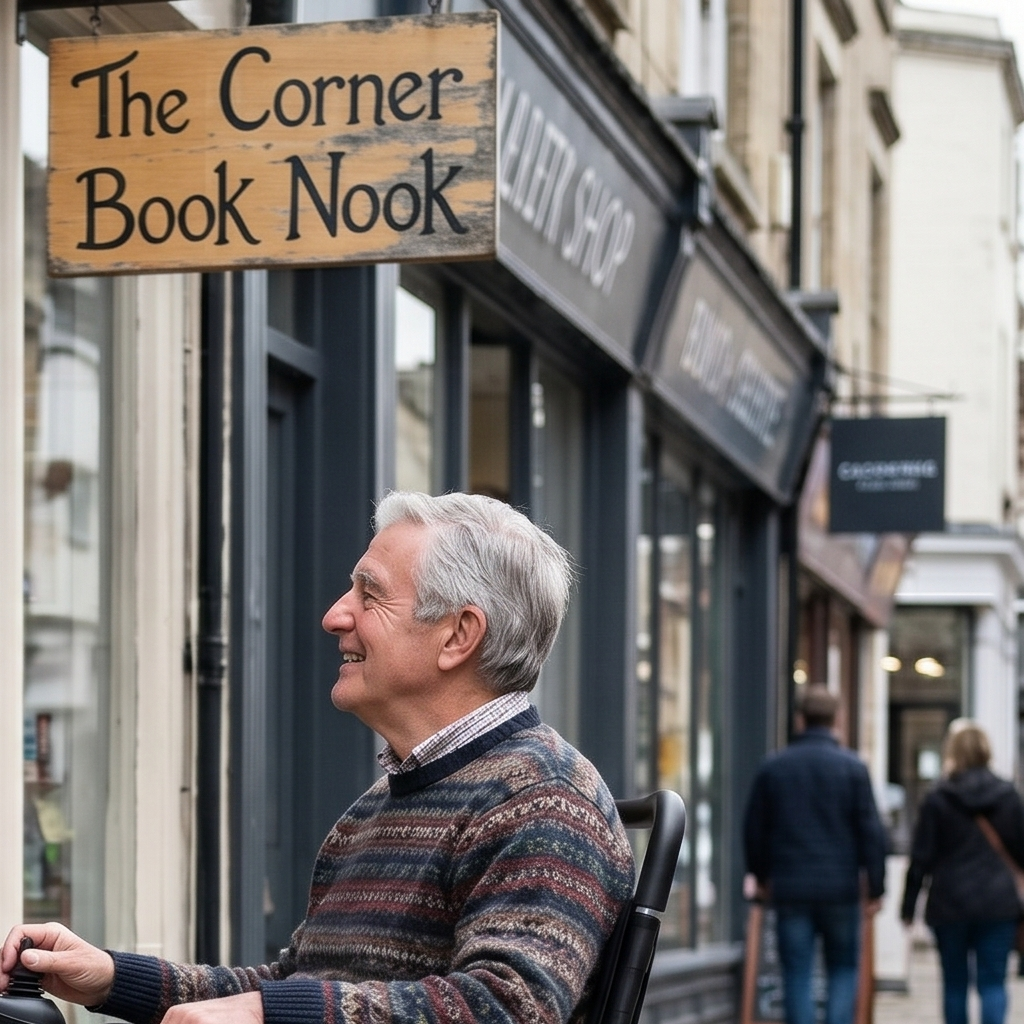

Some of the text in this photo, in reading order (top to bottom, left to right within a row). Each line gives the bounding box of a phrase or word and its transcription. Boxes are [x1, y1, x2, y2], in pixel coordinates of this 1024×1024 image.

[70, 45, 464, 139] The Corner
[75, 160, 262, 251] Book
[284, 147, 469, 241] Nook
[561, 165, 636, 298] SHOP
